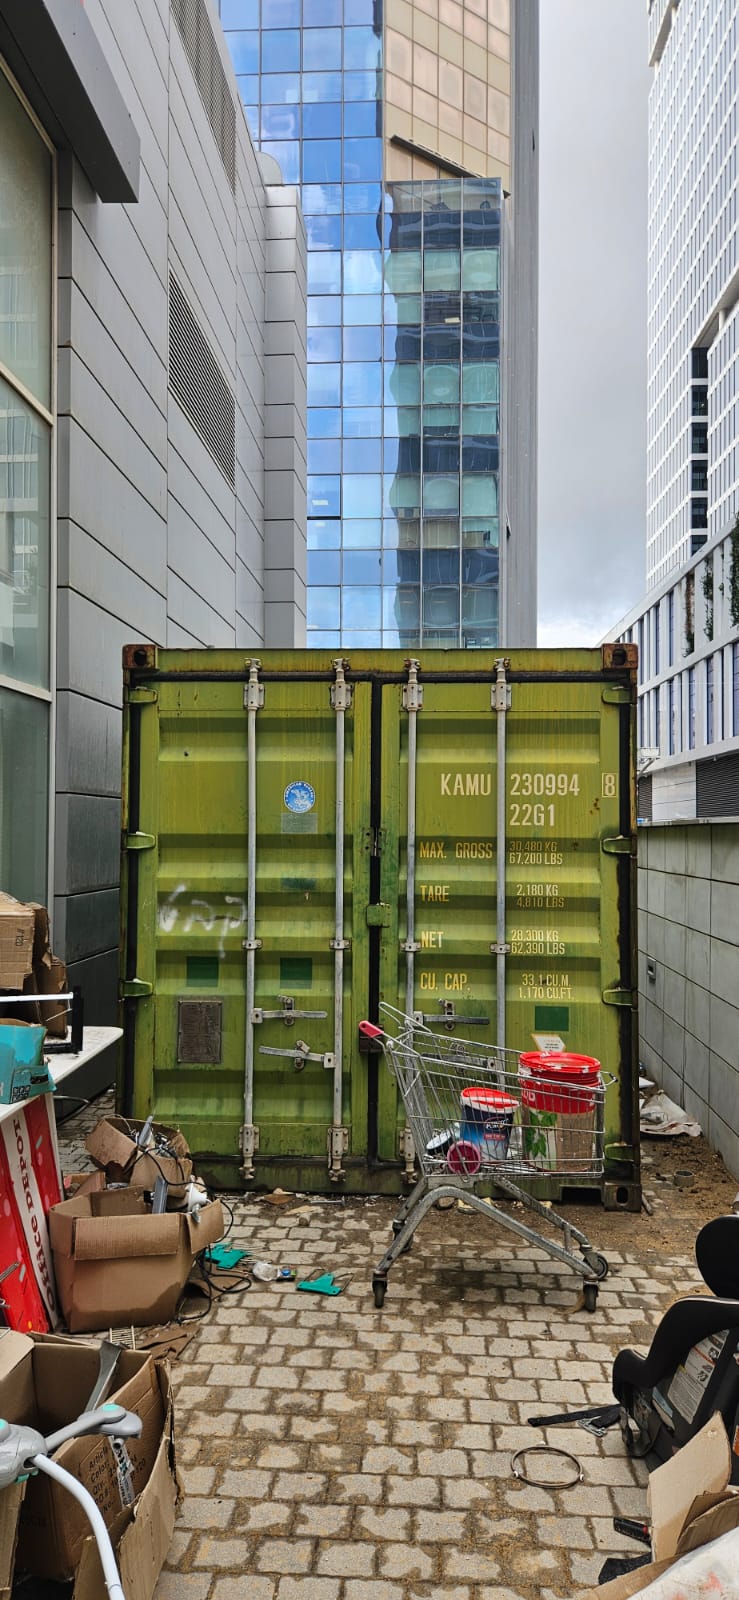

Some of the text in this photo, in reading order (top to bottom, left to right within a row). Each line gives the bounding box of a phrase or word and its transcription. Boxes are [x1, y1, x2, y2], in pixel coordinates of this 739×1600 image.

[440, 772, 616, 797] KAMU 230994 8
[509, 803, 555, 827] 22G1
[419, 841, 493, 859] MAX. GROSS
[544, 841, 557, 852] KG
[544, 853, 563, 865] LBS
[420, 885, 450, 902] TARE
[545, 884, 559, 896] KG
[546, 897, 564, 908] LBS
[421, 931, 444, 948] NET
[546, 930, 559, 941] KG
[546, 943, 565, 955] LBS
[420, 972, 471, 991] CU. CAP.
